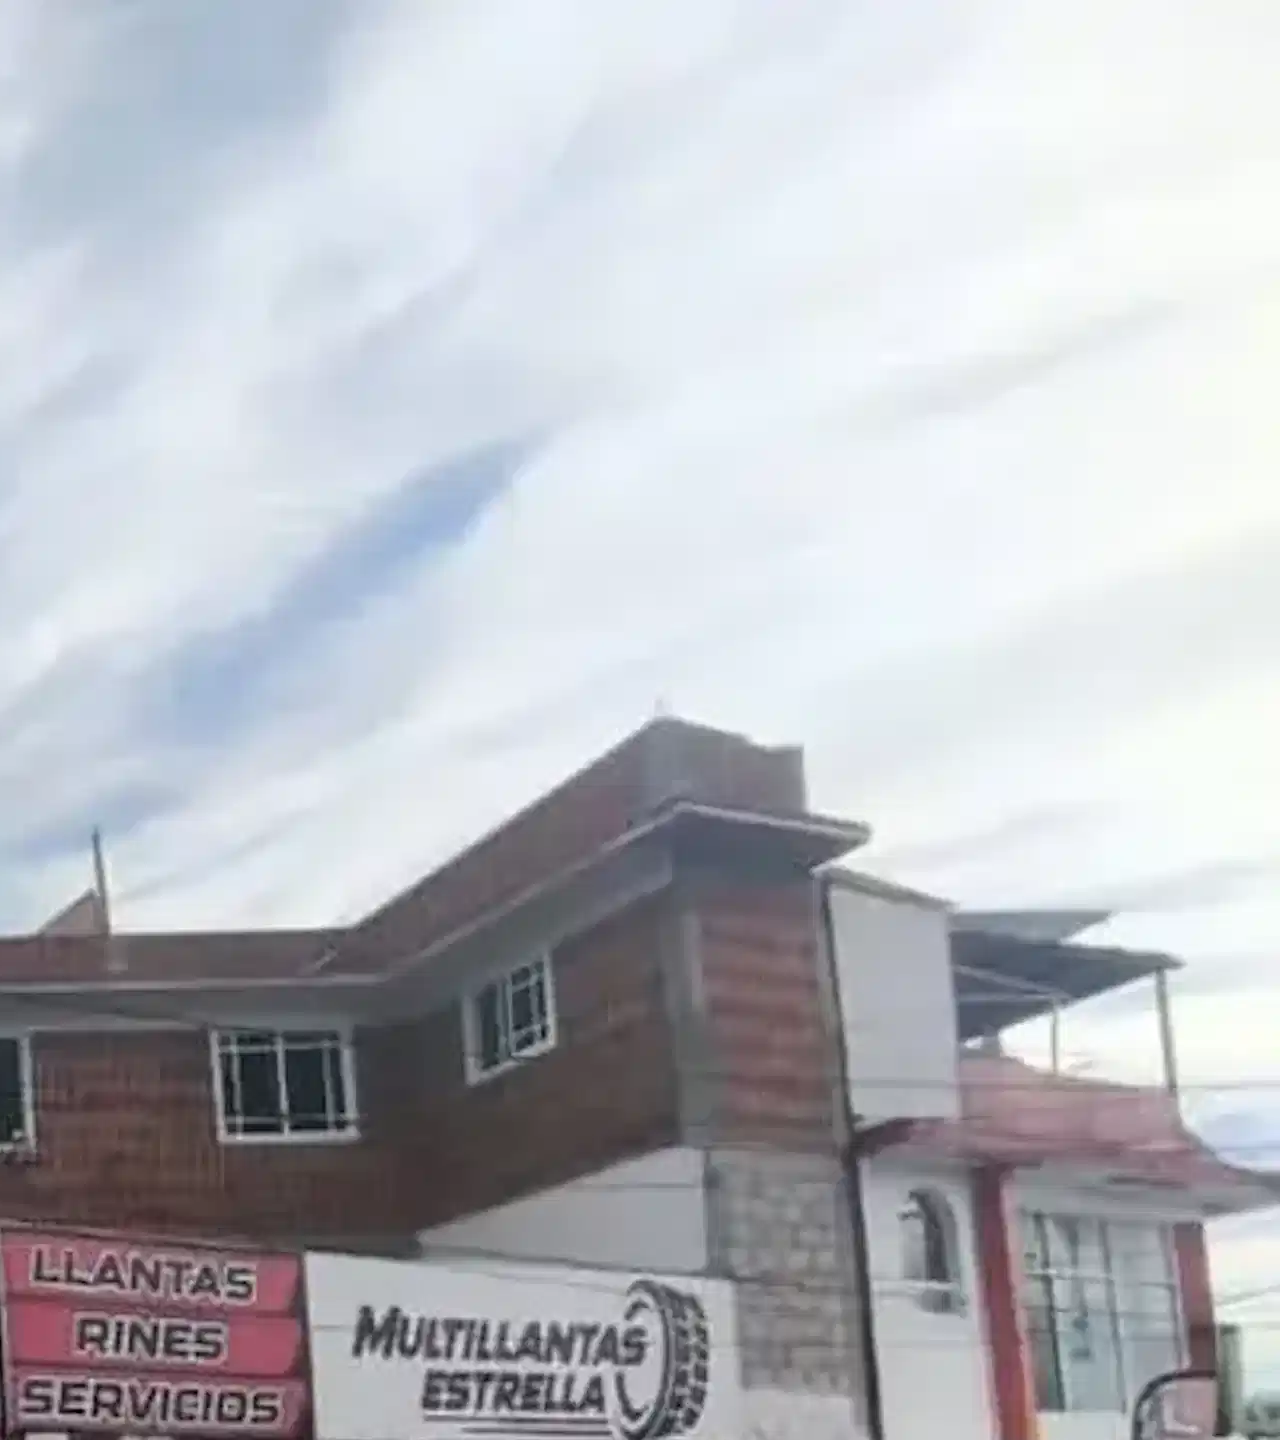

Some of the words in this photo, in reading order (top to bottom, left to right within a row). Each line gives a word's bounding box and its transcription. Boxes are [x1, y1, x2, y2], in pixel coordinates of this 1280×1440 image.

[30, 1246, 256, 1302] LLANTAS
[74, 1316, 225, 1361] RINES
[352, 1305, 646, 1366] MULTILLANTAS
[20, 1379, 281, 1425] SERVICIOS
[421, 1368, 606, 1412] ESTRELLA
